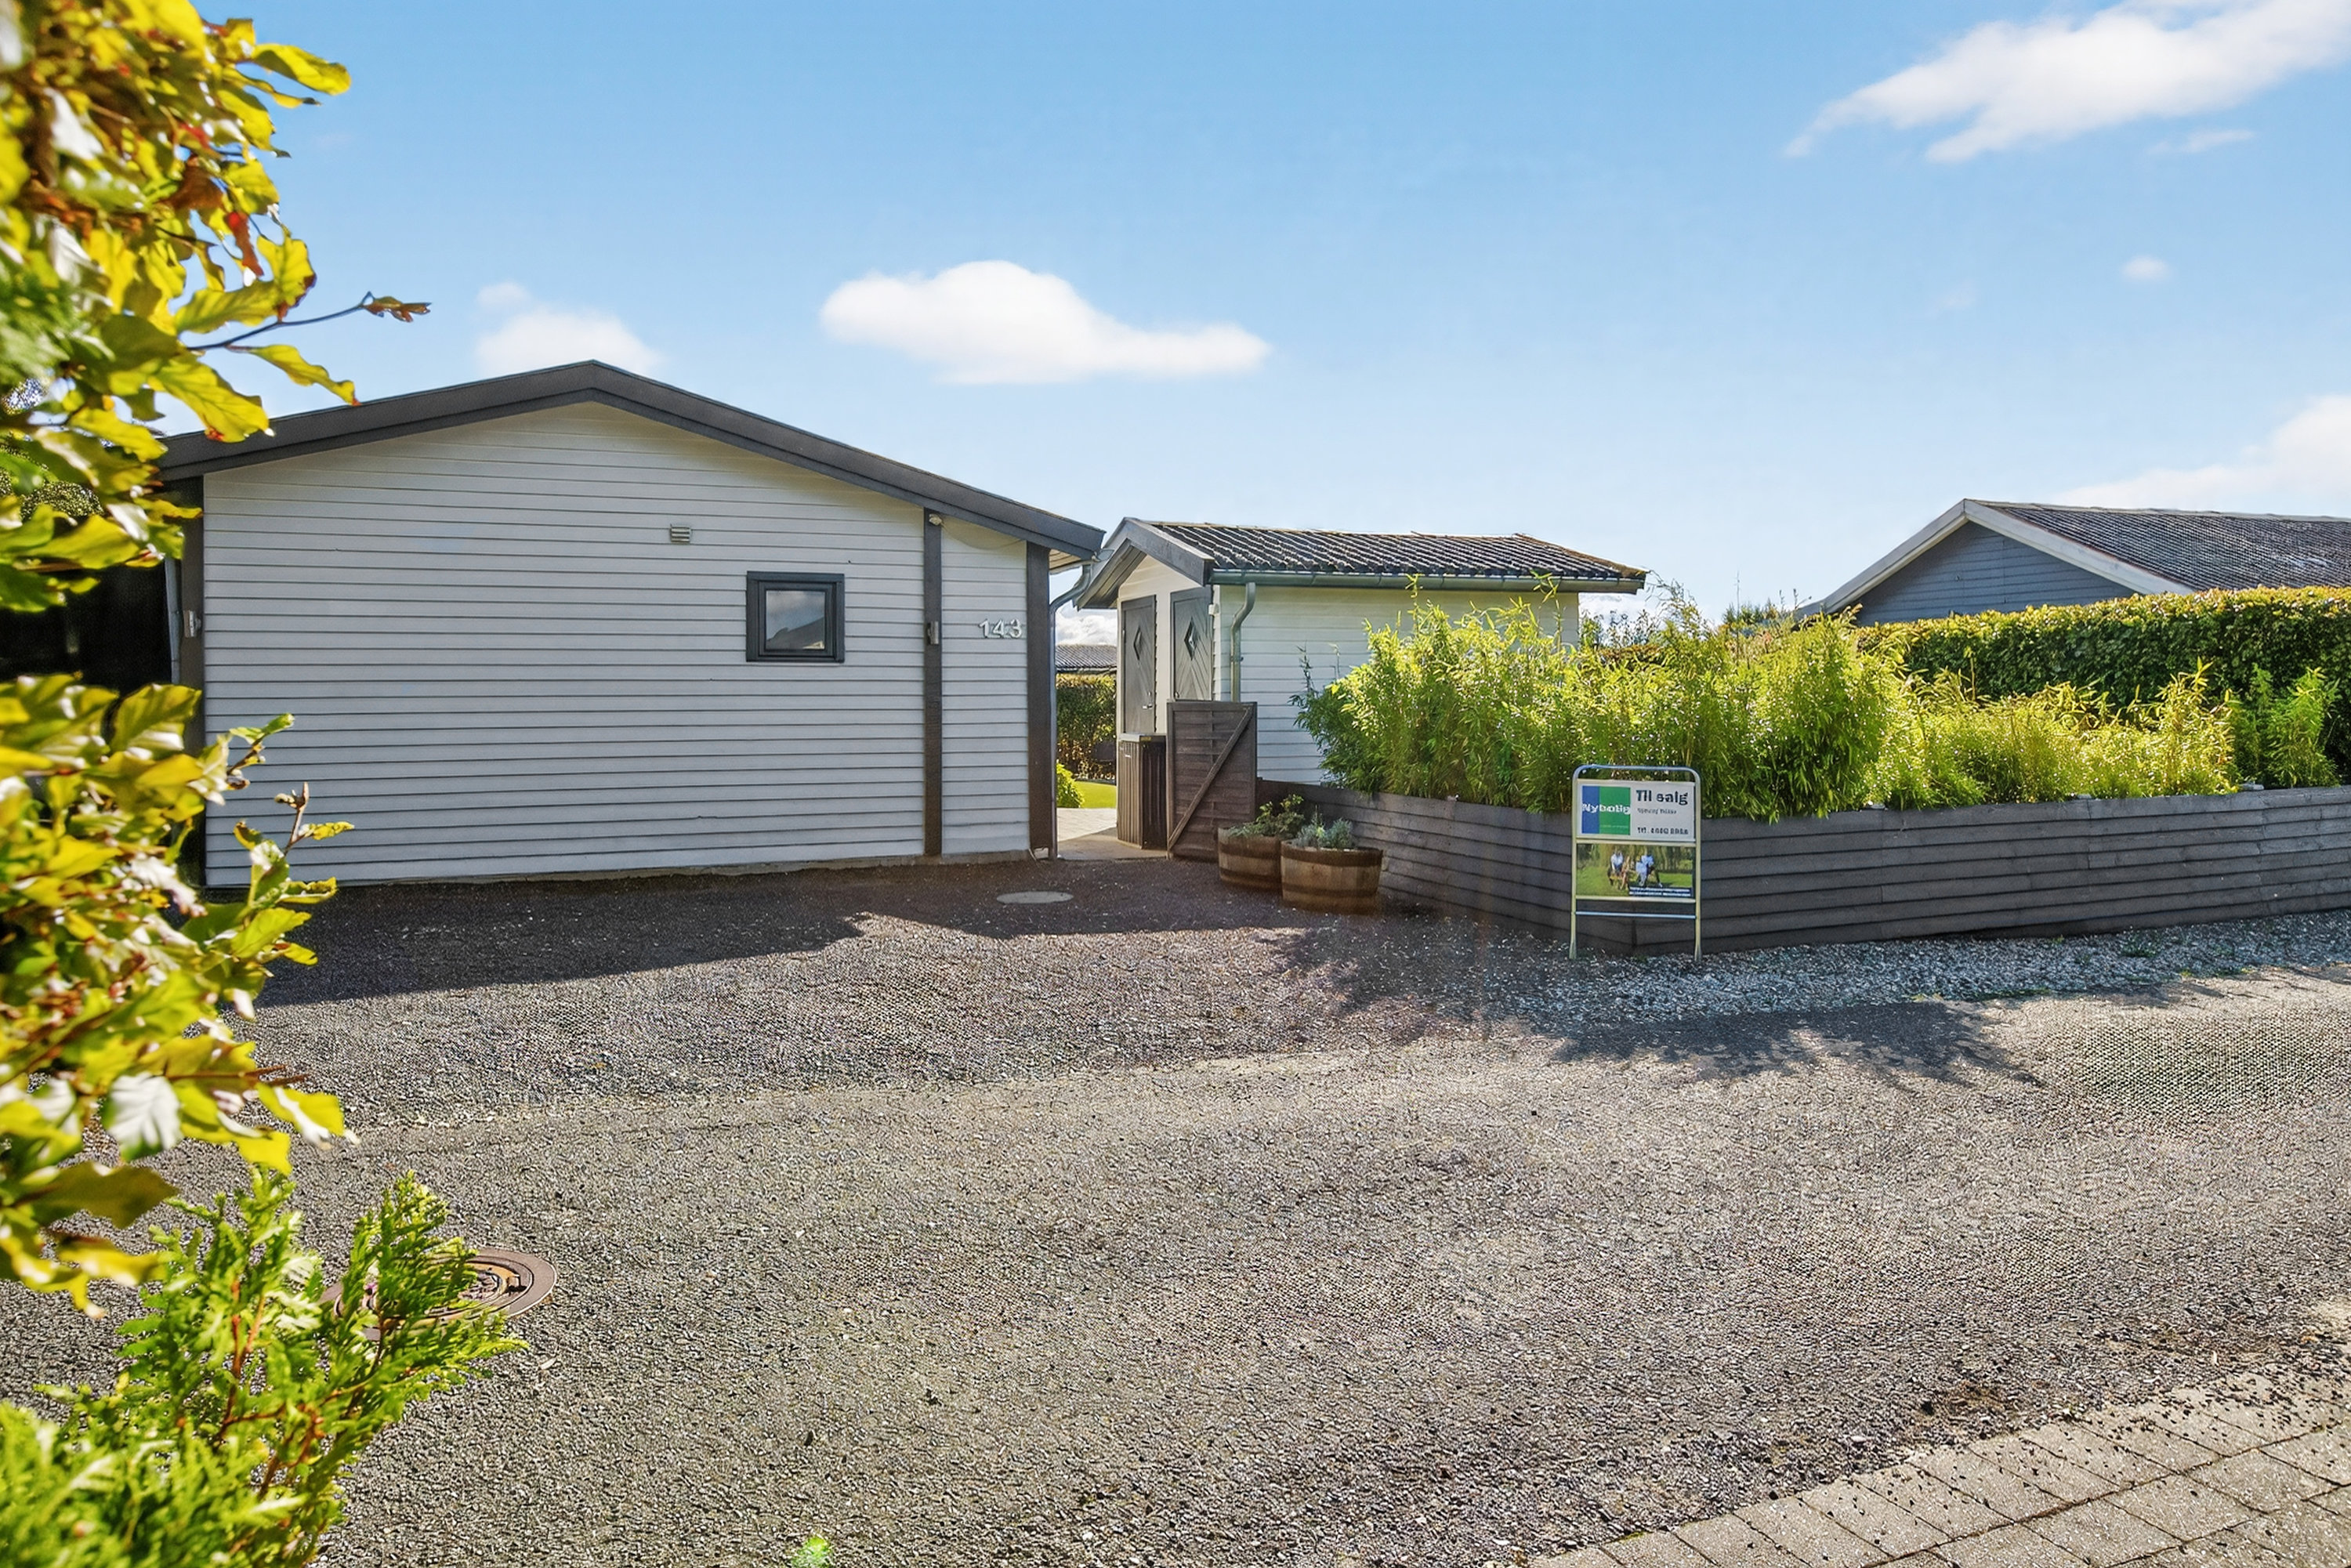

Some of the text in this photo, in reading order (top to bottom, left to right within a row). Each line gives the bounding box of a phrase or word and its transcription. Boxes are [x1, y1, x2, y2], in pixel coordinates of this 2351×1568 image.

[978, 618, 1022, 639] 143
[1656, 791, 1688, 806] salg
[1582, 803, 1631, 815] Nybolig
